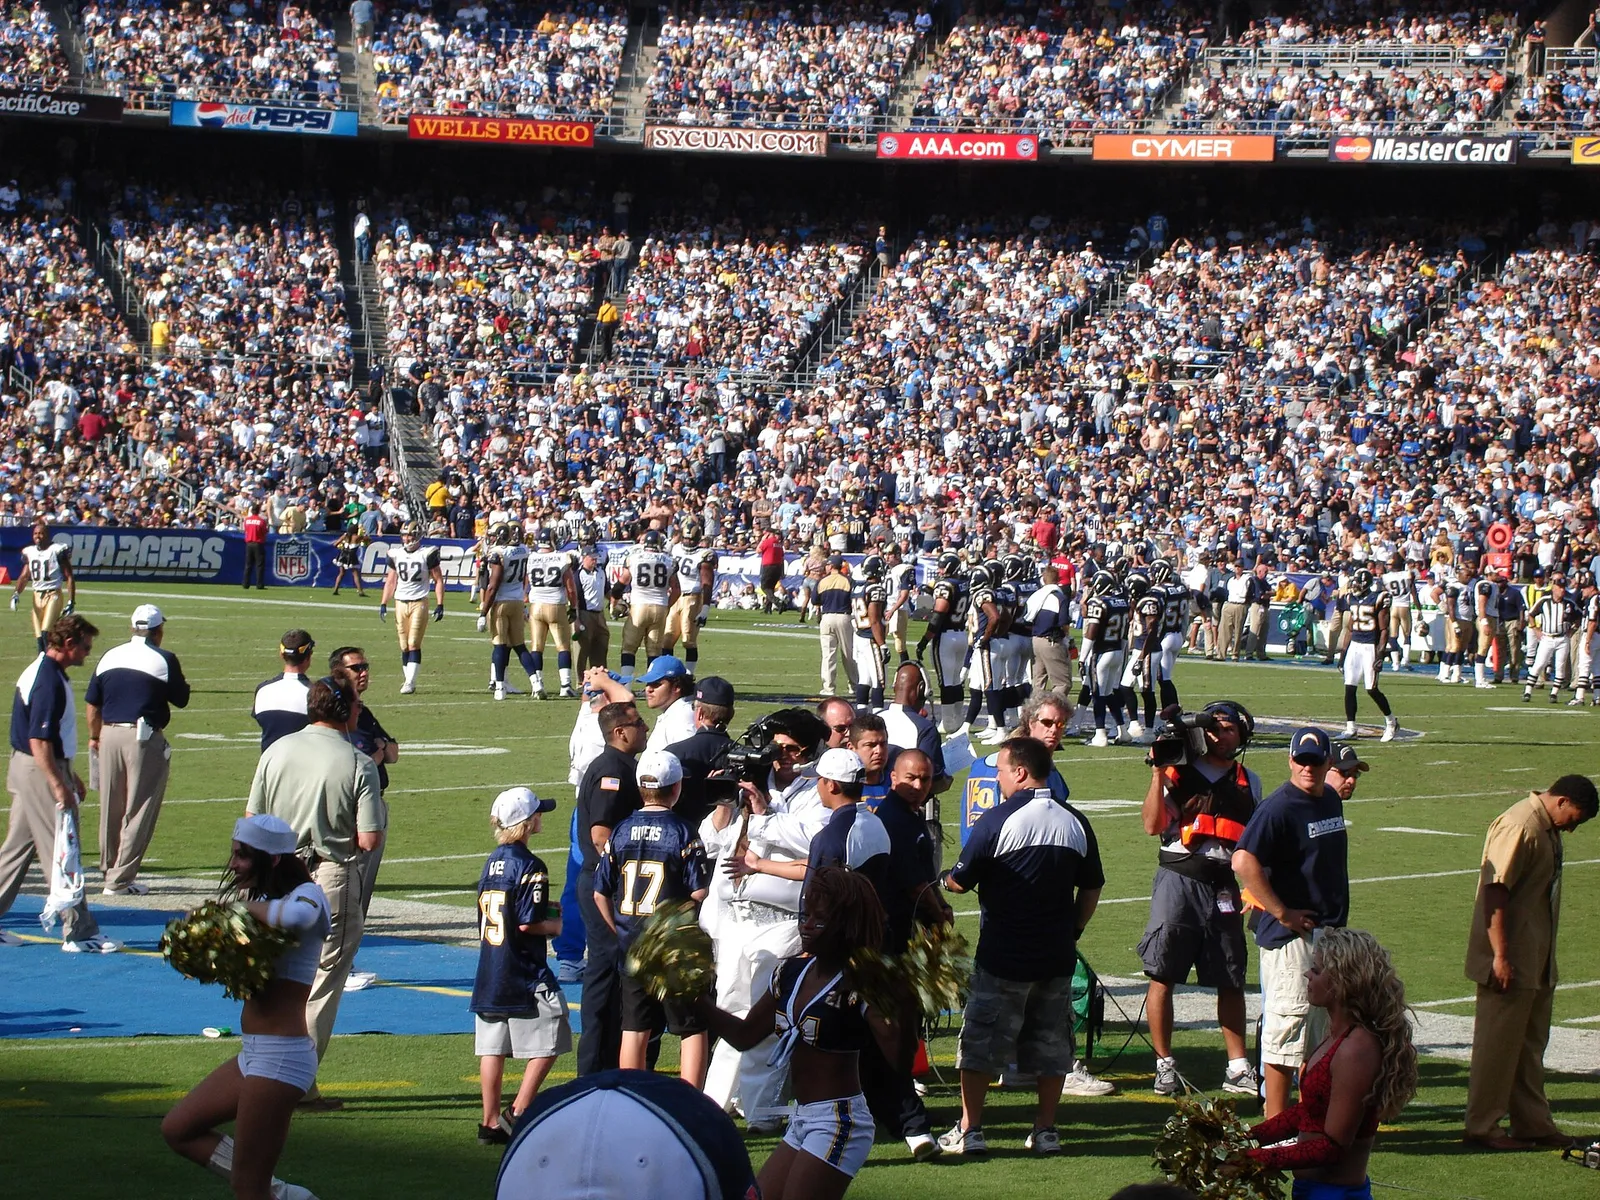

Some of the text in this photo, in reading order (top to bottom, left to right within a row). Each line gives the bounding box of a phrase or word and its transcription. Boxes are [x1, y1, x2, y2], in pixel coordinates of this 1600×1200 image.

[224, 107, 334, 130] diet PEPSI
[414, 118, 590, 142] WELLS FARGO
[653, 127, 817, 153] SYCUAN.COM
[908, 138, 1005, 156] AAA.com
[1131, 138, 1233, 157] CYMER
[1372, 138, 1513, 161] MasterCard
[31, 559, 49, 581] 81
[279, 557, 306, 577] NFL
[398, 561, 422, 582] 82
[531, 566, 562, 587] 62
[637, 563, 668, 588] 68
[1390, 579, 1407, 597] 91
[620, 859, 665, 916] 17
